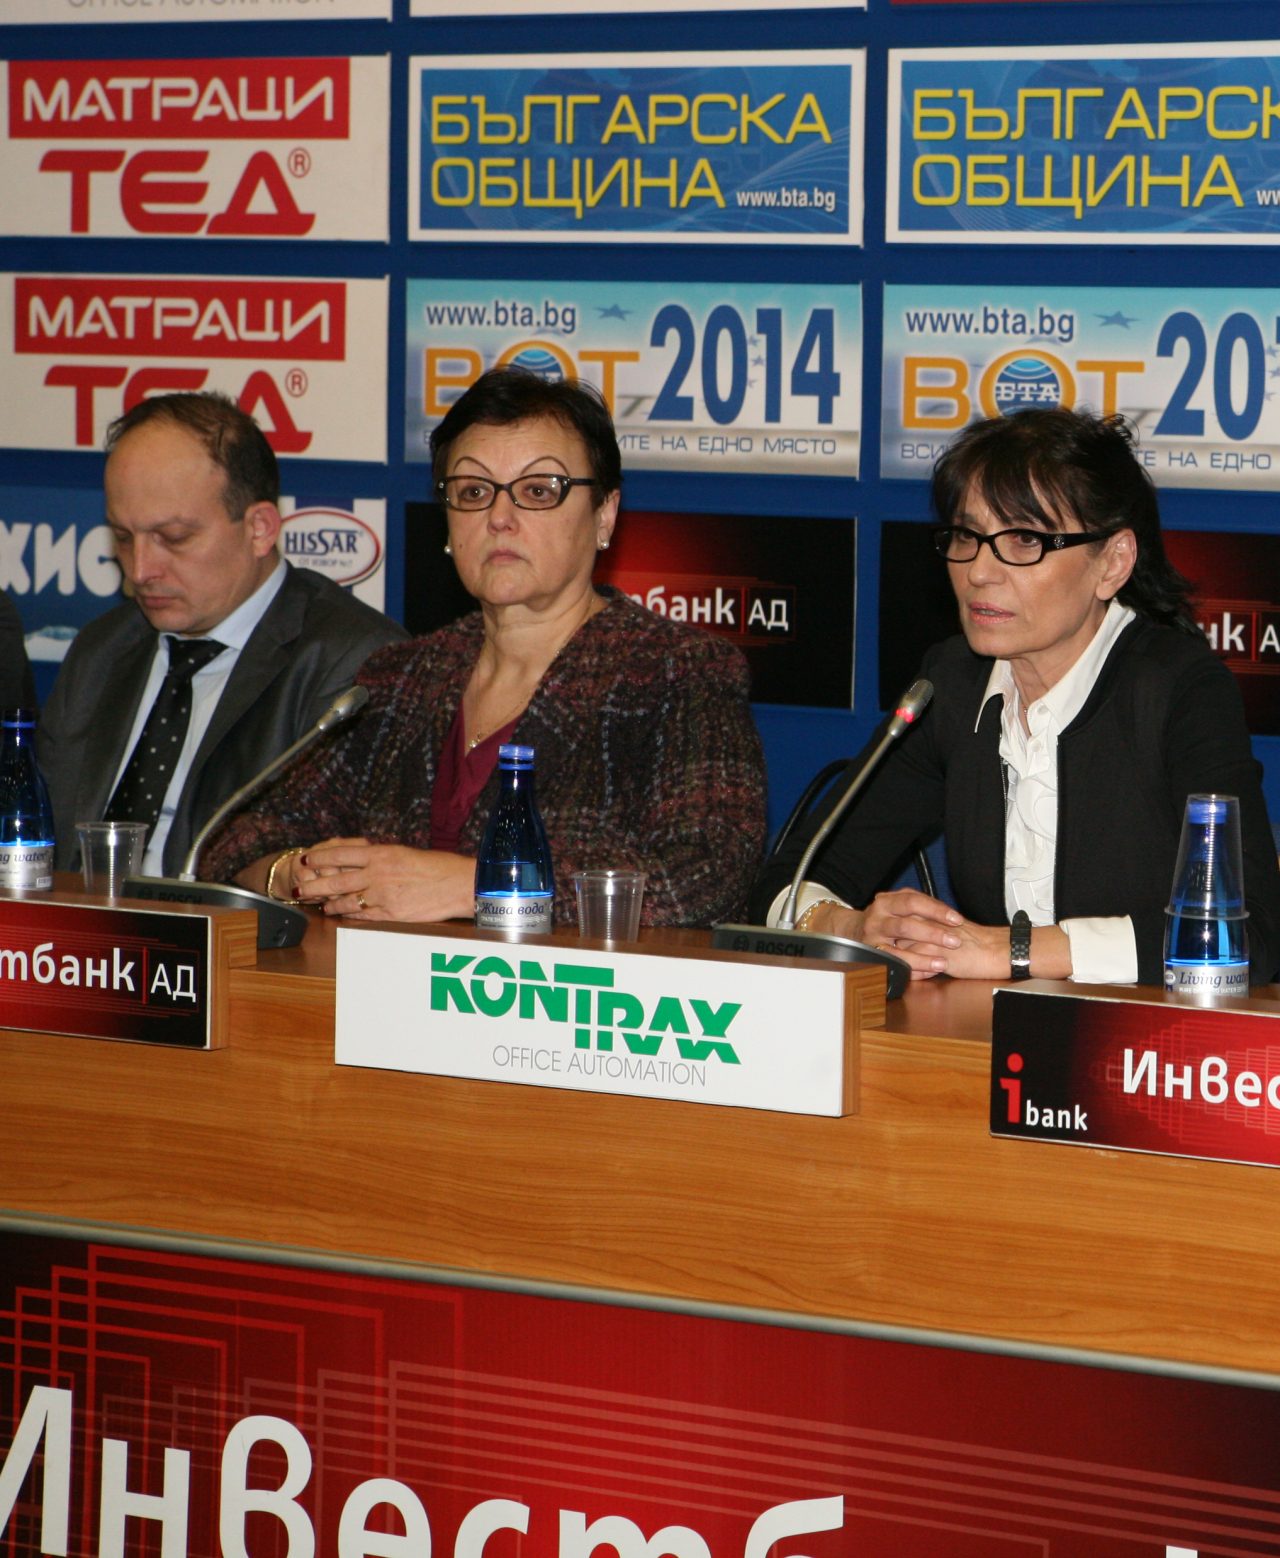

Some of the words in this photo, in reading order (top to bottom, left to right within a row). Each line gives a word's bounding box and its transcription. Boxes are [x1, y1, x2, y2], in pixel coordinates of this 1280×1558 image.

[22, 76, 334, 122] МАТРАЦИ
[430, 93, 833, 145] БЪЛГАРСКА
[431, 156, 727, 219] ОБЩИНА
[736, 187, 836, 212] www.bta.bg
[911, 153, 1245, 219] ОБЩИНА
[28, 294, 330, 343] МАТРАЦИ
[426, 300, 576, 333] www.bta.bg
[905, 306, 1075, 342] www.bta.bg
[648, 304, 841, 425] 2014
[996, 383, 1059, 402] БТА
[661, 435, 688, 451] НА
[698, 436, 753, 455] ЕДНО
[763, 437, 836, 455] МЯСТО
[1168, 451, 1198, 467] НА
[1210, 452, 1272, 472] ЕДНО
[0, 520, 122, 597] ХИС
[285, 528, 358, 556] HISSAR
[747, 597, 789, 632] АД
[480, 902, 514, 915] Жива
[517, 901, 545, 915] вода
[755, 939, 805, 957] BOSCH
[150, 963, 197, 1003] АД
[1179, 971, 1222, 989] Living
[430, 952, 743, 1066] KONTRAX
[492, 1044, 562, 1072] OFFICE
[567, 1052, 706, 1087] AUTOMATION
